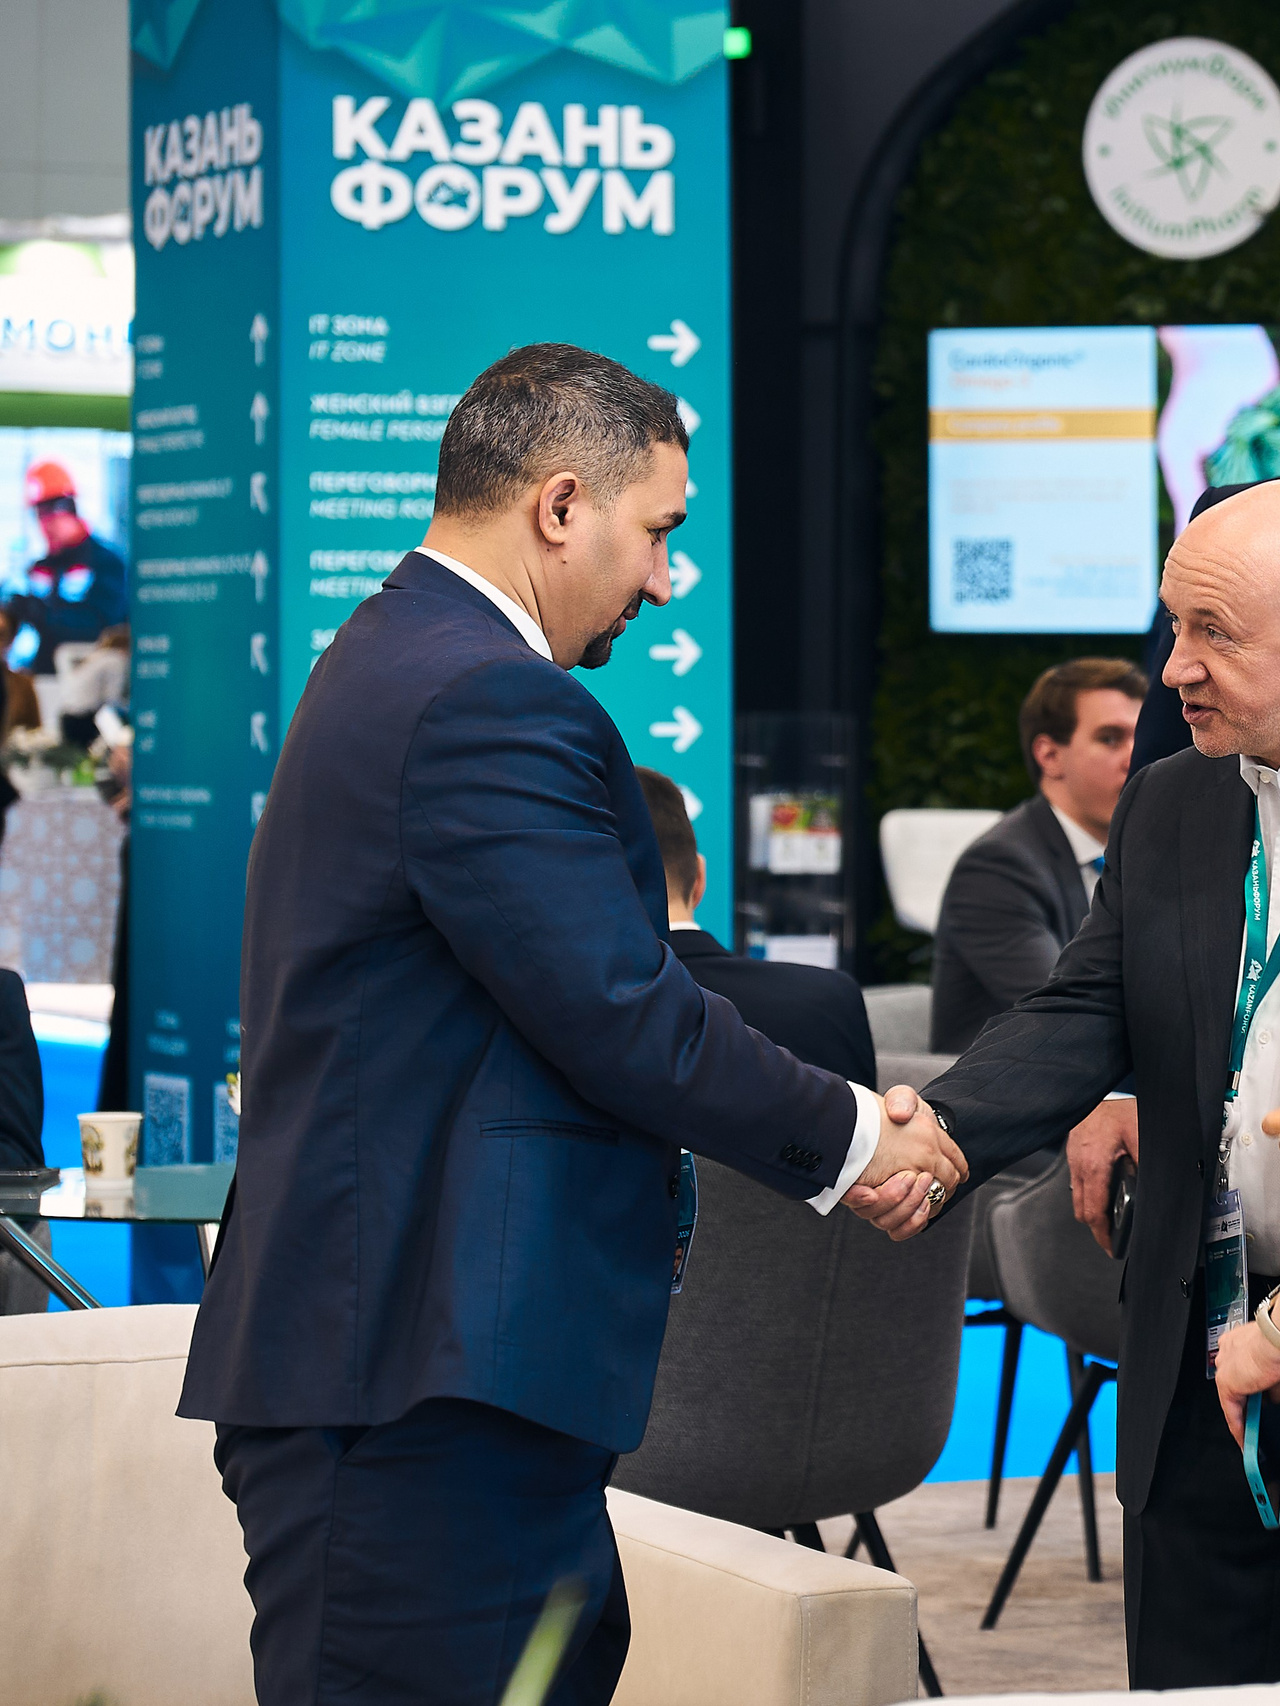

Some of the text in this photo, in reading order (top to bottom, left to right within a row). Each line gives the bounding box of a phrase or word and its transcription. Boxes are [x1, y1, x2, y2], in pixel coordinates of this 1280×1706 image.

[144, 102, 264, 187] КАЗАНЬ
[331, 94, 676, 171] КАЗАНЬ
[143, 165, 264, 252] ФОРУМ
[330, 158, 676, 236] ФОРУМ
[309, 313, 390, 337] IT ЗОНА
[308, 339, 387, 363] IT ZONE
[310, 389, 414, 415] ЖЕНСКИЙ
[309, 418, 450, 442] FEMALE PERSP
[309, 471, 438, 494] ПЕРЕГОВОРН
[309, 497, 398, 520] MEETING
[309, 576, 389, 598] MEETIN
[1251, 859, 1261, 921] КАЗАНЬФОРУМ
[1241, 984, 1257, 1034] KAZANFORU
